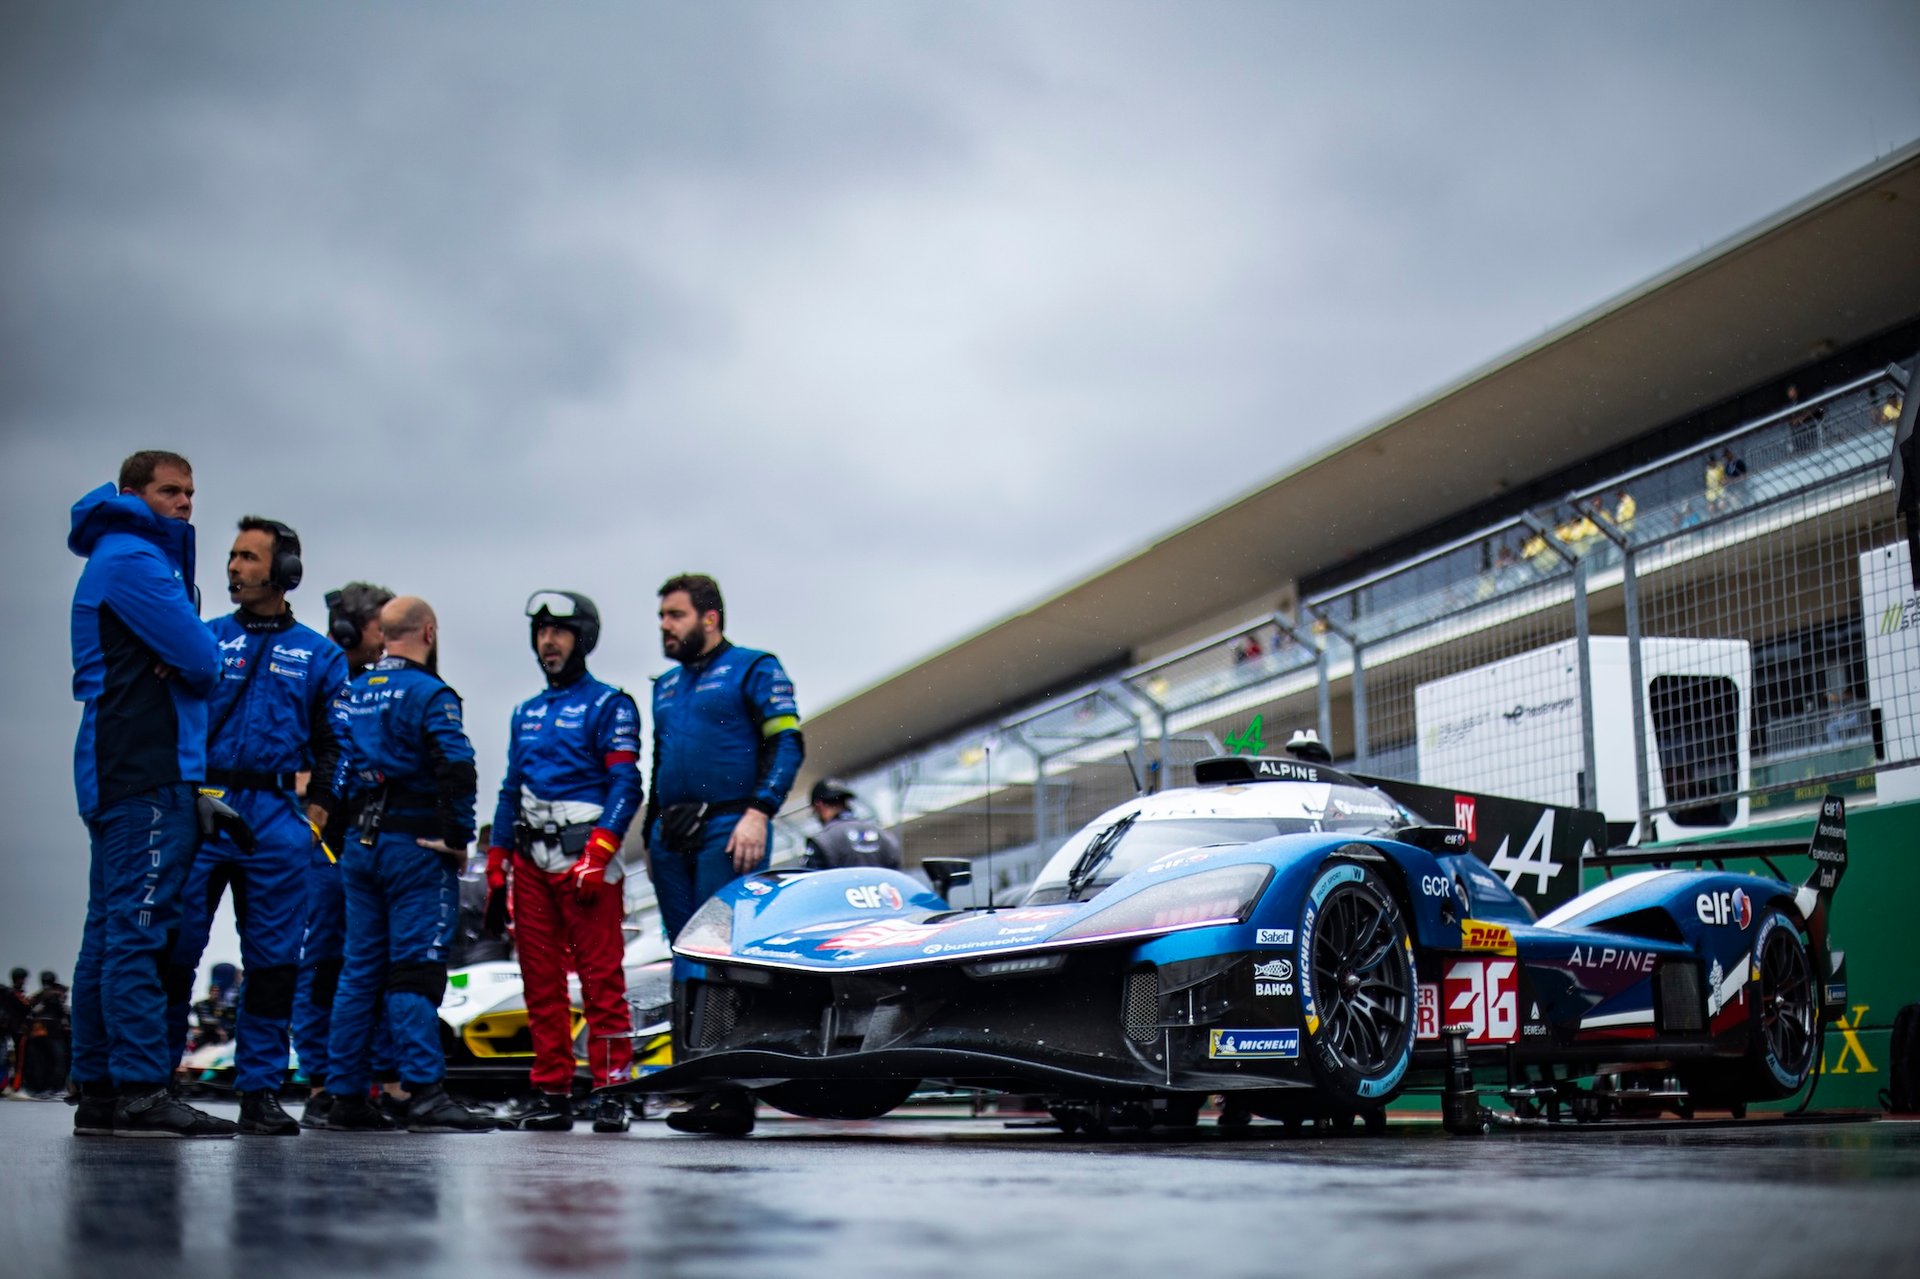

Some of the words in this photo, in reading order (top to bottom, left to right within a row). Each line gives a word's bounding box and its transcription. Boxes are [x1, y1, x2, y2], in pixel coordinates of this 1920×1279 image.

[350, 689, 405, 704] LPINE
[1260, 761, 1318, 782] ALPINE
[1455, 803, 1475, 834] HY
[1824, 802, 1836, 817] elf
[1444, 834, 1458, 845] elf
[138, 806, 163, 928] ALPINE
[1352, 867, 1362, 880] W
[1316, 883, 1328, 900] PILOT
[1327, 871, 1342, 887] SPORT
[1421, 875, 1451, 899] GCR
[845, 886, 883, 909] elf
[1696, 891, 1731, 926] elf
[943, 935, 1038, 952] businessolver
[1261, 930, 1290, 943] Sabelt
[1469, 928, 1509, 947] DHL
[1301, 907, 1316, 998] MICHELIN
[1567, 944, 1657, 972] ALPINE
[1255, 983, 1294, 996] BAHCO
[1445, 961, 1518, 1040] 36
[1239, 1039, 1297, 1051] MICHELIN
